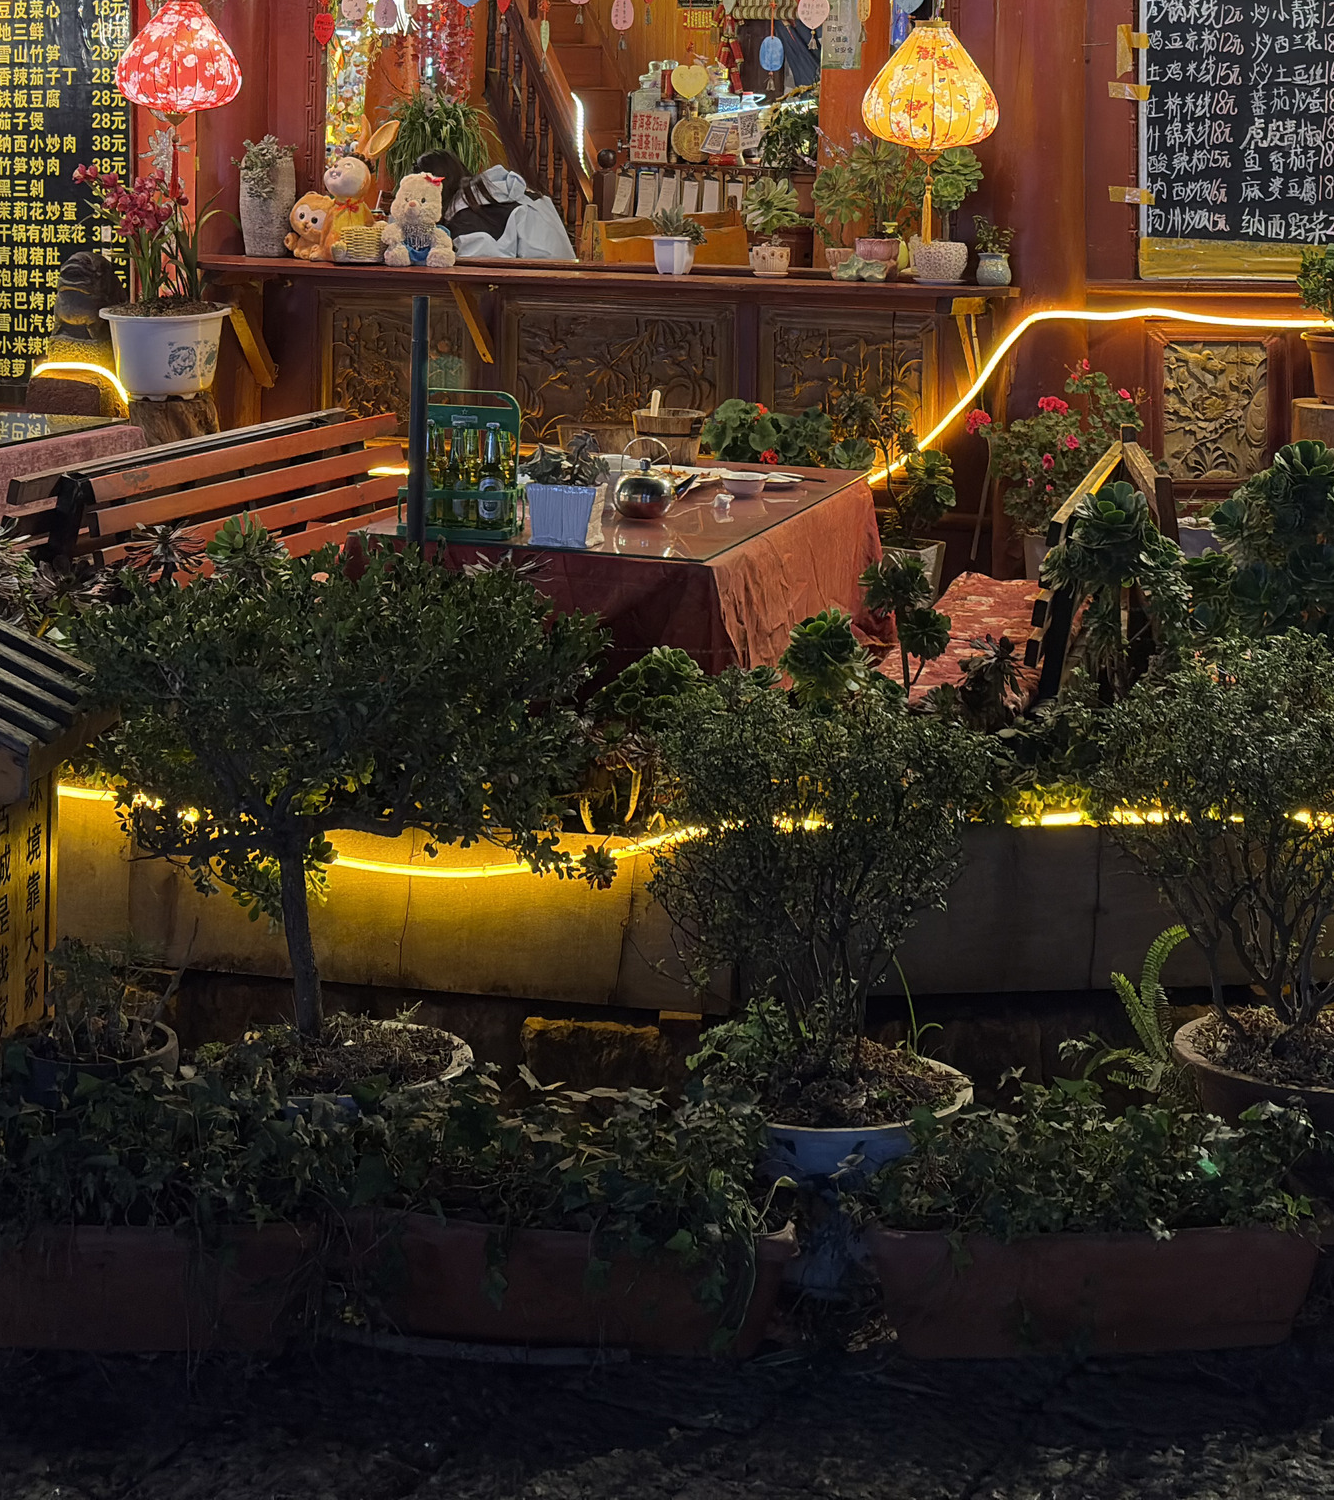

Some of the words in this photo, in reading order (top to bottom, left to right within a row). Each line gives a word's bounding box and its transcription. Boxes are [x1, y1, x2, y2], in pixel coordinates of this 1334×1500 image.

[92, 67, 119, 84] 28
[92, 112, 126, 129] 28元
[92, 134, 126, 152] 38元
